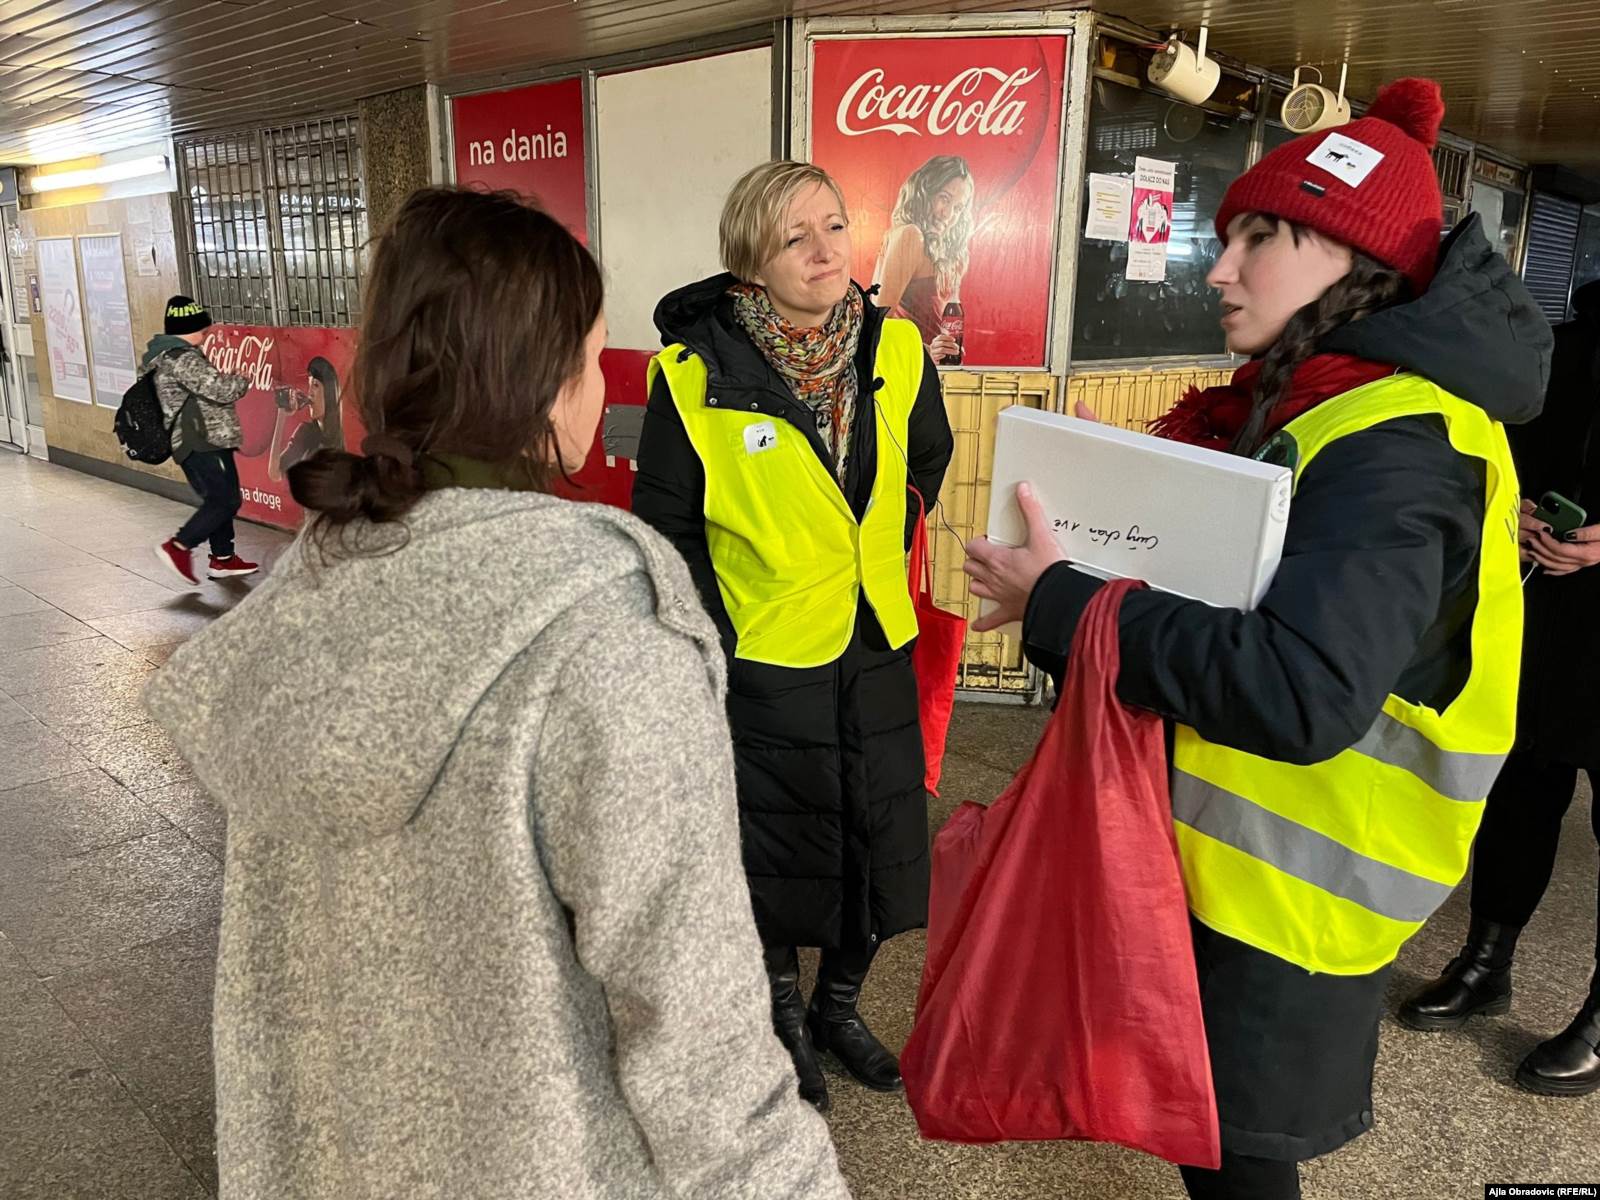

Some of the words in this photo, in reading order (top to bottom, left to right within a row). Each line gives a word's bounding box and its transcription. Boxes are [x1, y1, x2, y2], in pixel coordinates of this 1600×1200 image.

[836, 67, 1041, 136] Coca-Cola
[469, 139, 496, 166] na
[502, 124, 567, 162] dania
[252, 487, 282, 512] drogę
